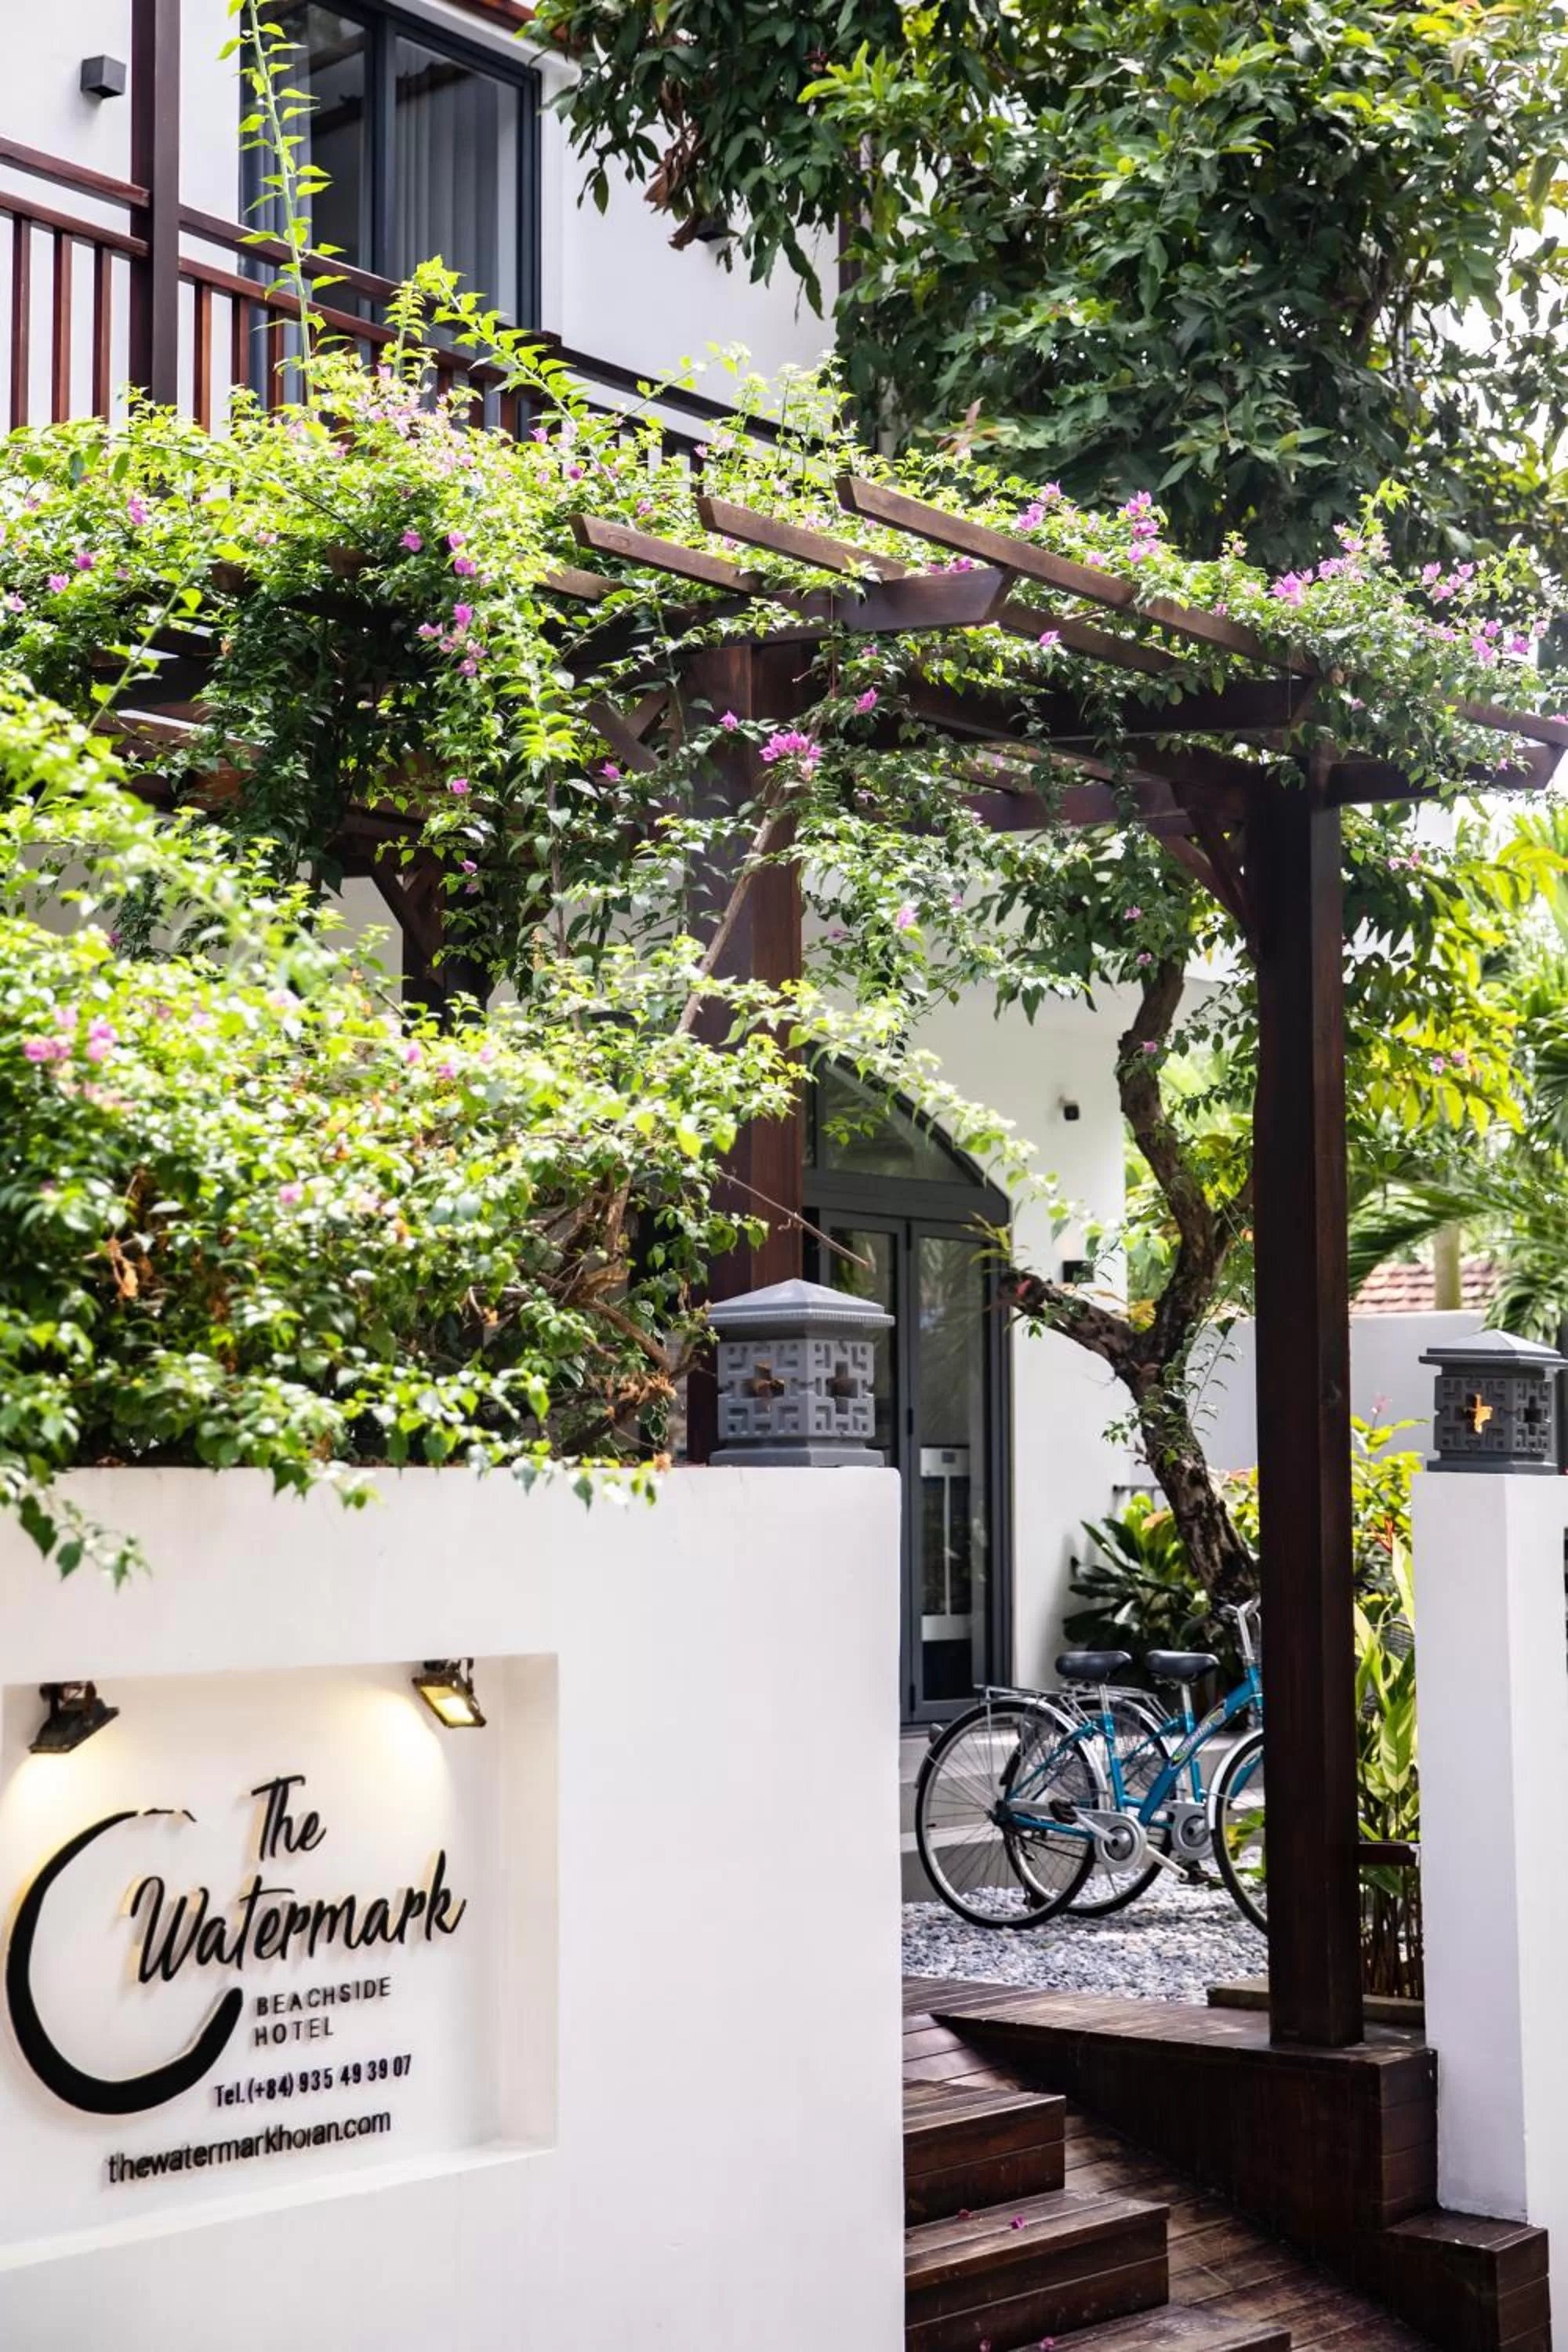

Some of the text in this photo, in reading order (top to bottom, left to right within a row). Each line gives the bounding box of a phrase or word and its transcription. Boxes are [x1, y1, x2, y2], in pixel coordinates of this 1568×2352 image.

[251, 1774, 327, 1861] The
[130, 1849, 466, 1984] Watermark
[256, 1976, 391, 2016] BEACHSIDE
[255, 2016, 334, 2047] HOTEL
[299, 2067, 333, 2092] 935
[339, 2063, 362, 2086] 49
[367, 2059, 388, 2082] 39
[393, 2054, 412, 2078] 07
[107, 2111, 392, 2183] thewatermarkhoian.com
